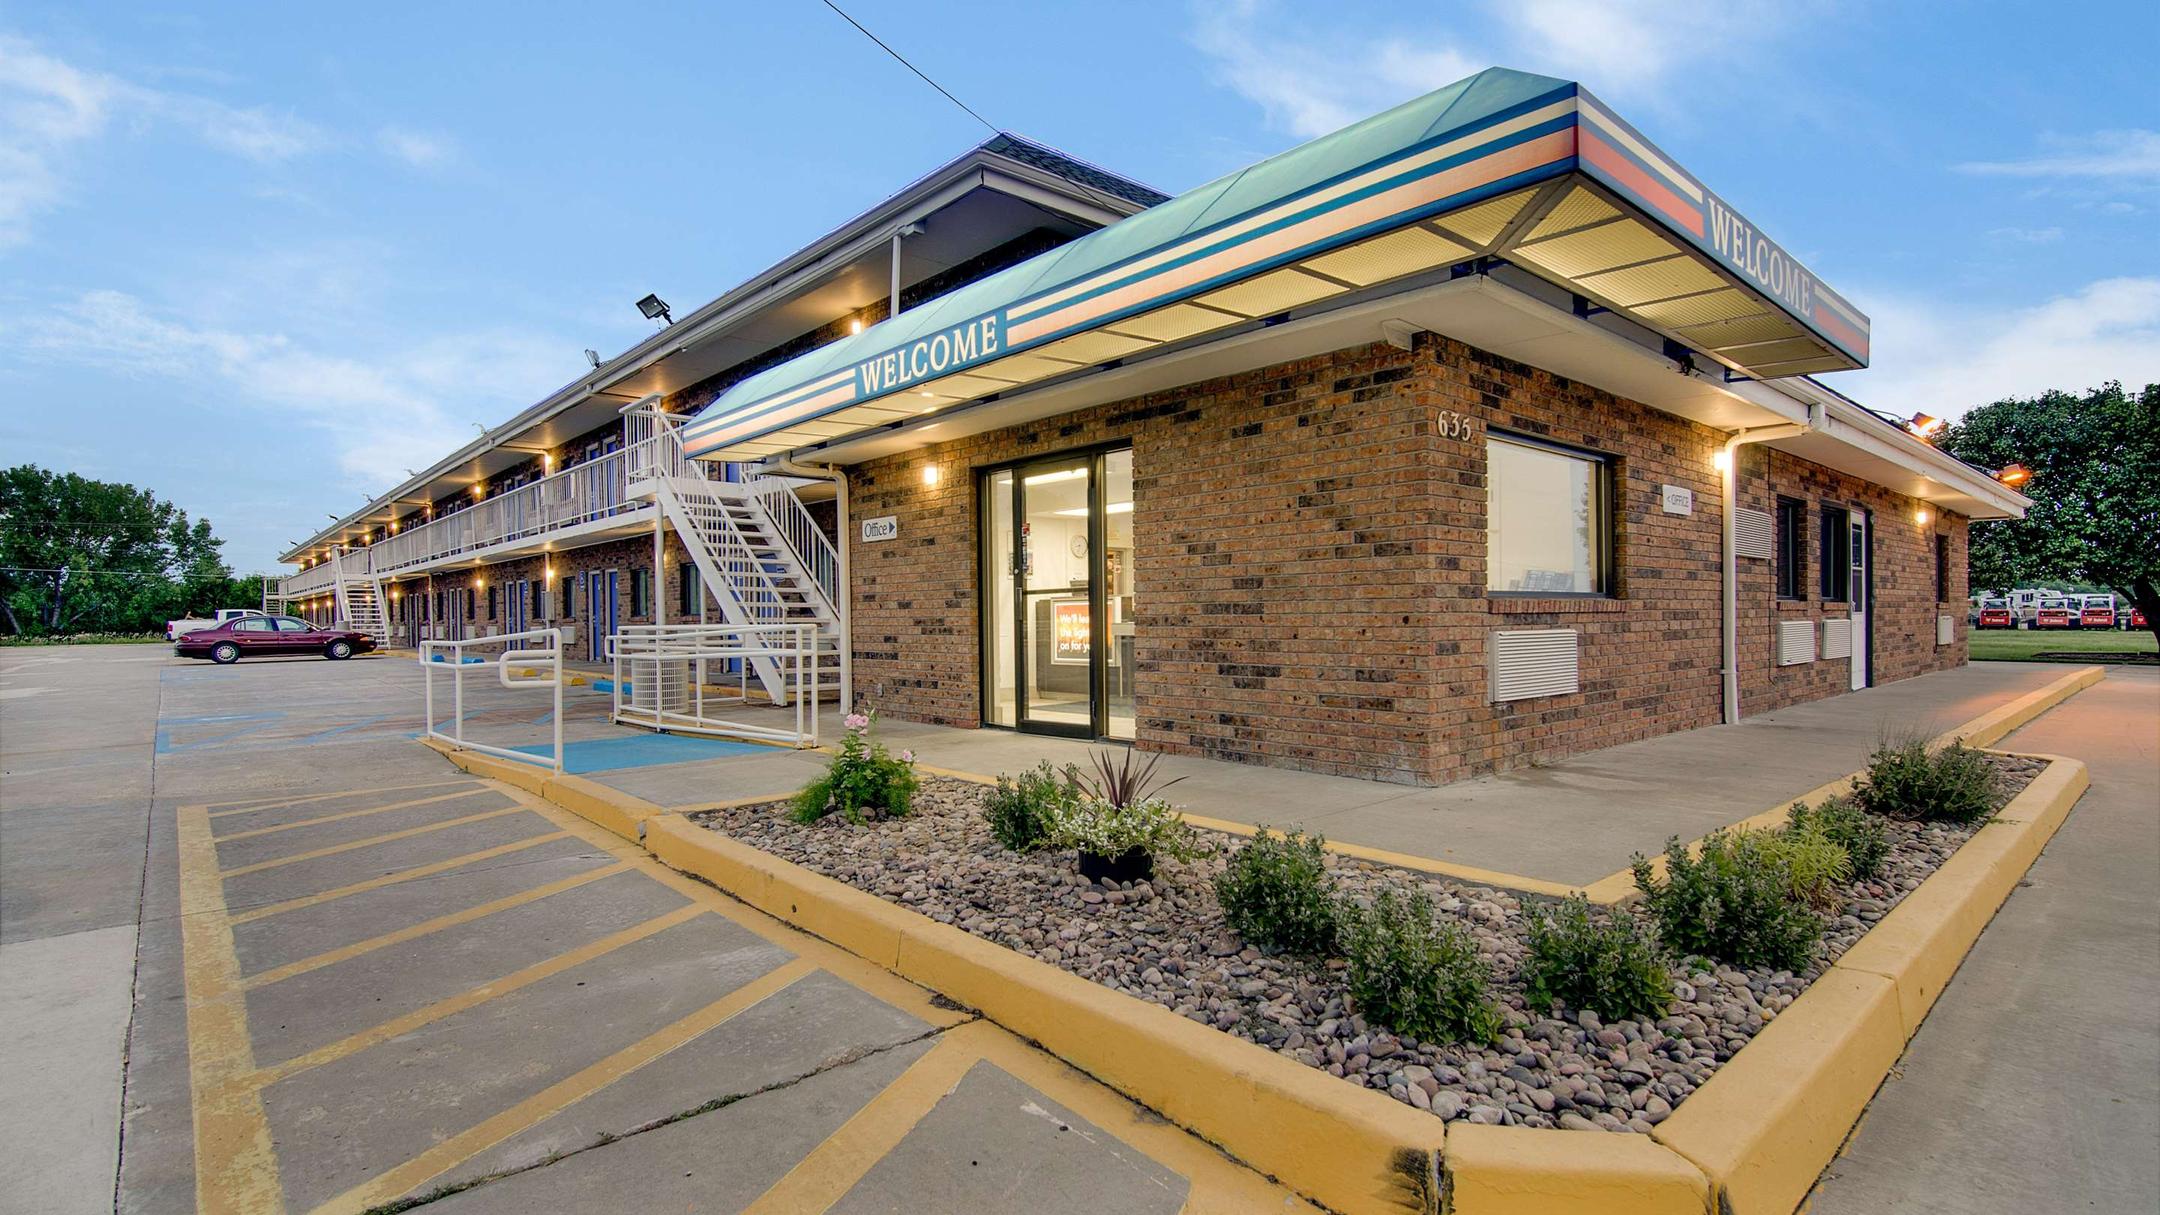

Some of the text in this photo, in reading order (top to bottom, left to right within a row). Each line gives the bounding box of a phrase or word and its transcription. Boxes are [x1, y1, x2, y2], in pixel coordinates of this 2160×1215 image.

[1708, 197, 1811, 317] WELCOME
[860, 315, 998, 395] WELCOME
[1437, 410, 1471, 442] 635
[864, 522, 888, 538] Office
[1071, 640, 1082, 650] for
